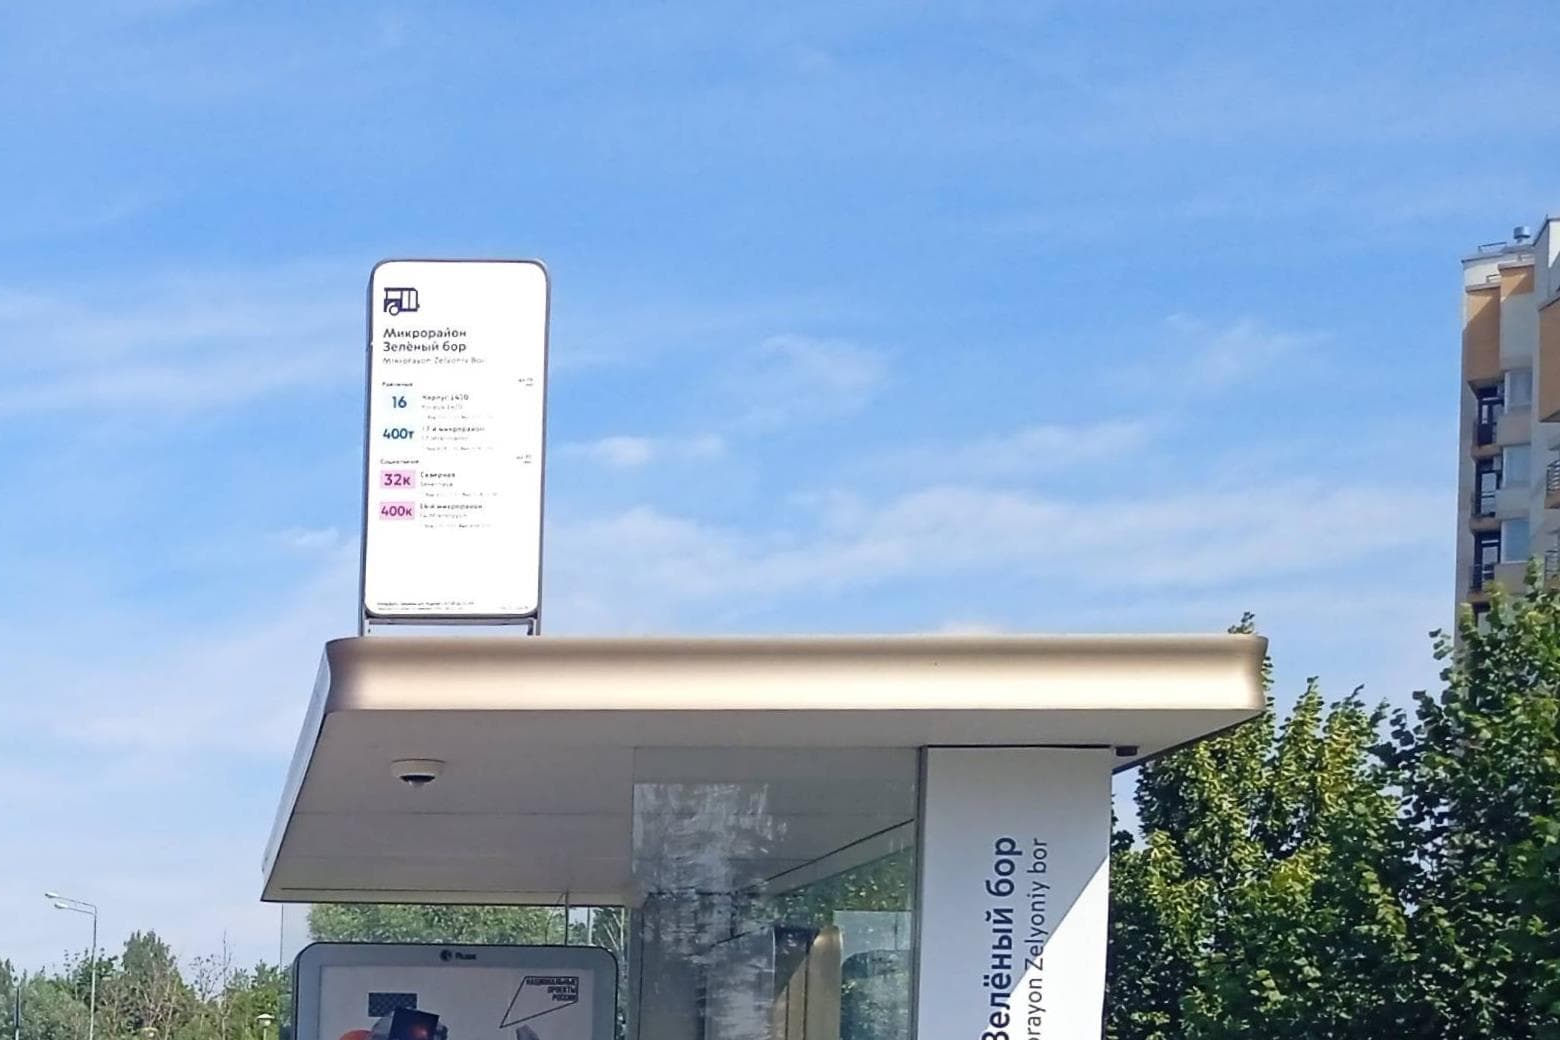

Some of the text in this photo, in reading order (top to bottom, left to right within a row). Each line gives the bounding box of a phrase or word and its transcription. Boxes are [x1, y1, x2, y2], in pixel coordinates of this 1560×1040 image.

[383, 327, 466, 340] Микрорайон
[383, 340, 466, 353] Зелёный бор
[392, 395, 407, 409] 16
[382, 427, 415, 440] 400т
[383, 473, 411, 486] 32к
[381, 505, 413, 517] 400к
[1026, 838, 1048, 873] bor
[985, 837, 1023, 897] бор
[1024, 881, 1051, 972] Zelyoniy
